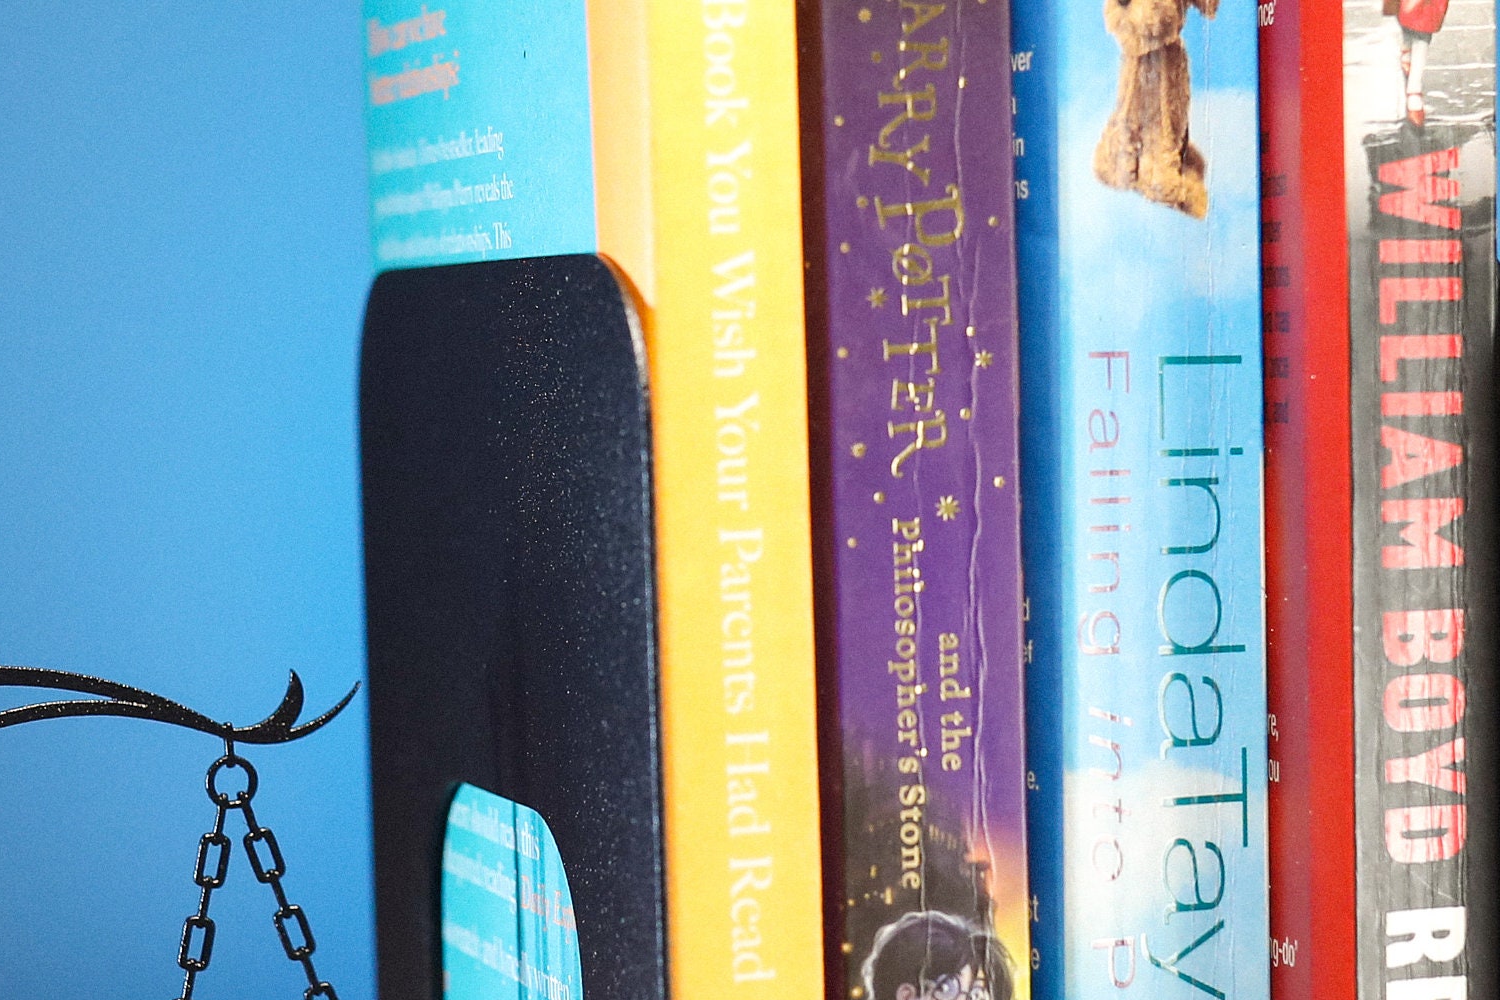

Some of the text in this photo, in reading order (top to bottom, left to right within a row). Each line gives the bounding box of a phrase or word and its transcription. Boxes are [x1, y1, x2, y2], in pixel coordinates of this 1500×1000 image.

[493, 221, 513, 250] This
[500, 172, 514, 200] the
[868, 0, 965, 478] ARRY POTTER
[701, 0, 777, 983] Book You Wish Your Parents Had Read
[1077, 350, 1132, 656] Falling
[1376, 145, 1468, 866] WILLIAM BOYD
[888, 517, 928, 891] Philosopher's Stone
[938, 632, 973, 772] and the
[1088, 704, 1134, 883] into
[521, 821, 540, 861] this
